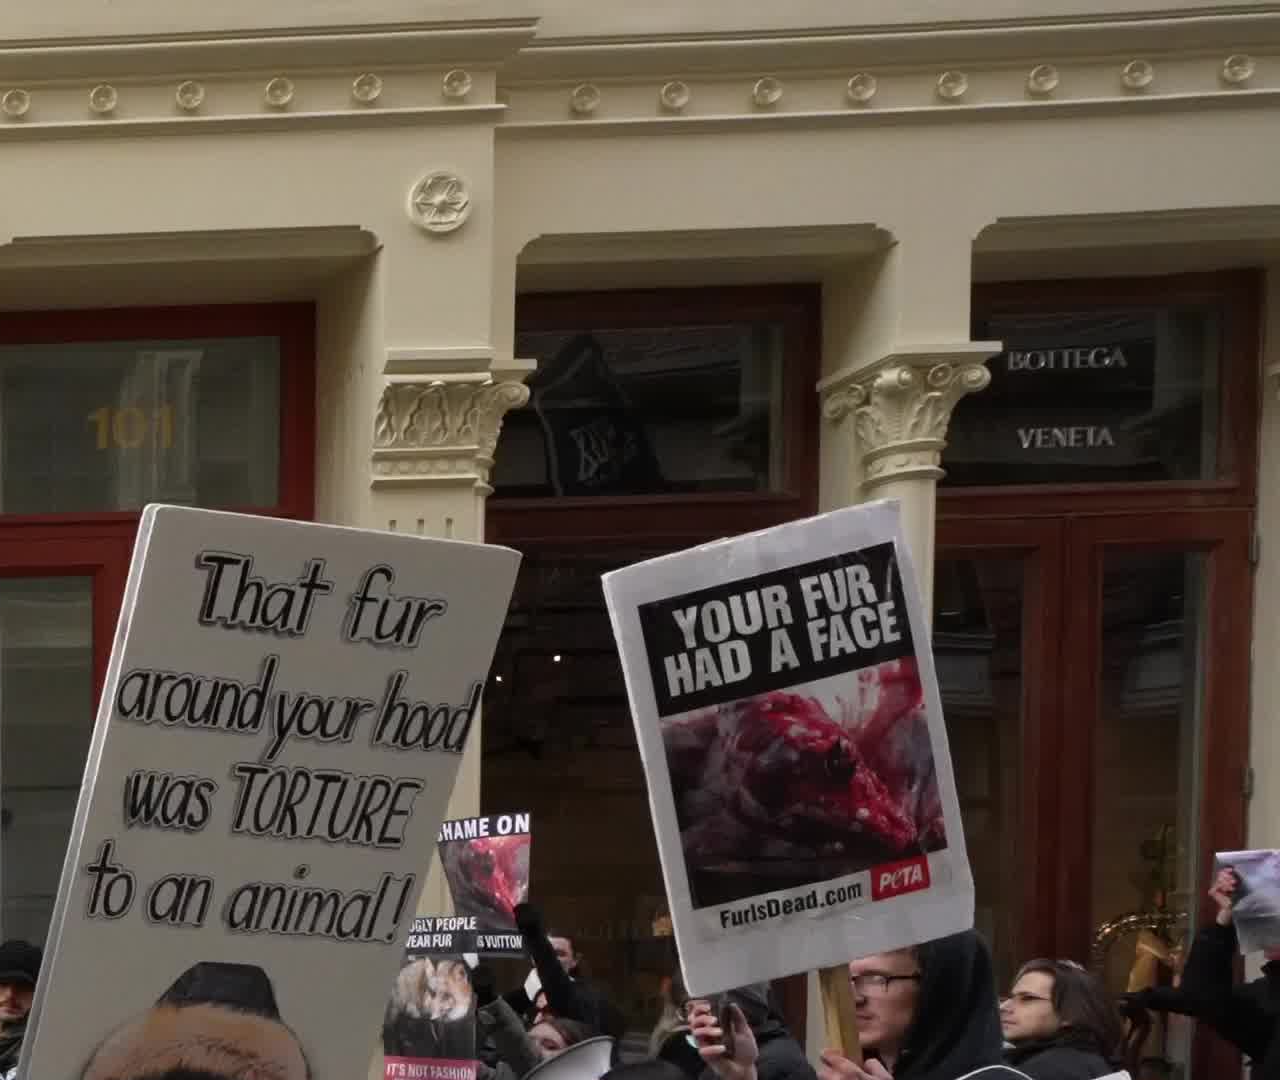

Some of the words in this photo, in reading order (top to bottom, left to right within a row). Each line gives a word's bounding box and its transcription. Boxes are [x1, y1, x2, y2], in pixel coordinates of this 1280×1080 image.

[1007, 347, 1128, 370] BOTTEGA
[1016, 426, 1116, 448] VENETA
[198, 552, 334, 635] That
[348, 565, 446, 647] fur
[672, 585, 793, 649] YOUR
[799, 564, 878, 619] FUR
[663, 639, 753, 697] HAD
[770, 628, 800, 673] A
[807, 600, 902, 663] FACE
[117, 655, 280, 734] around
[263, 691, 375, 763] your
[374, 671, 484, 752] hood
[125, 770, 217, 830] was
[232, 762, 426, 848] TORTURE
[496, 813, 530, 835] ON
[87, 839, 137, 919] to
[146, 873, 215, 926] an
[226, 863, 418, 942] animal!
[436, 916, 478, 931] PEOPLE
[432, 933, 453, 947] FUR
